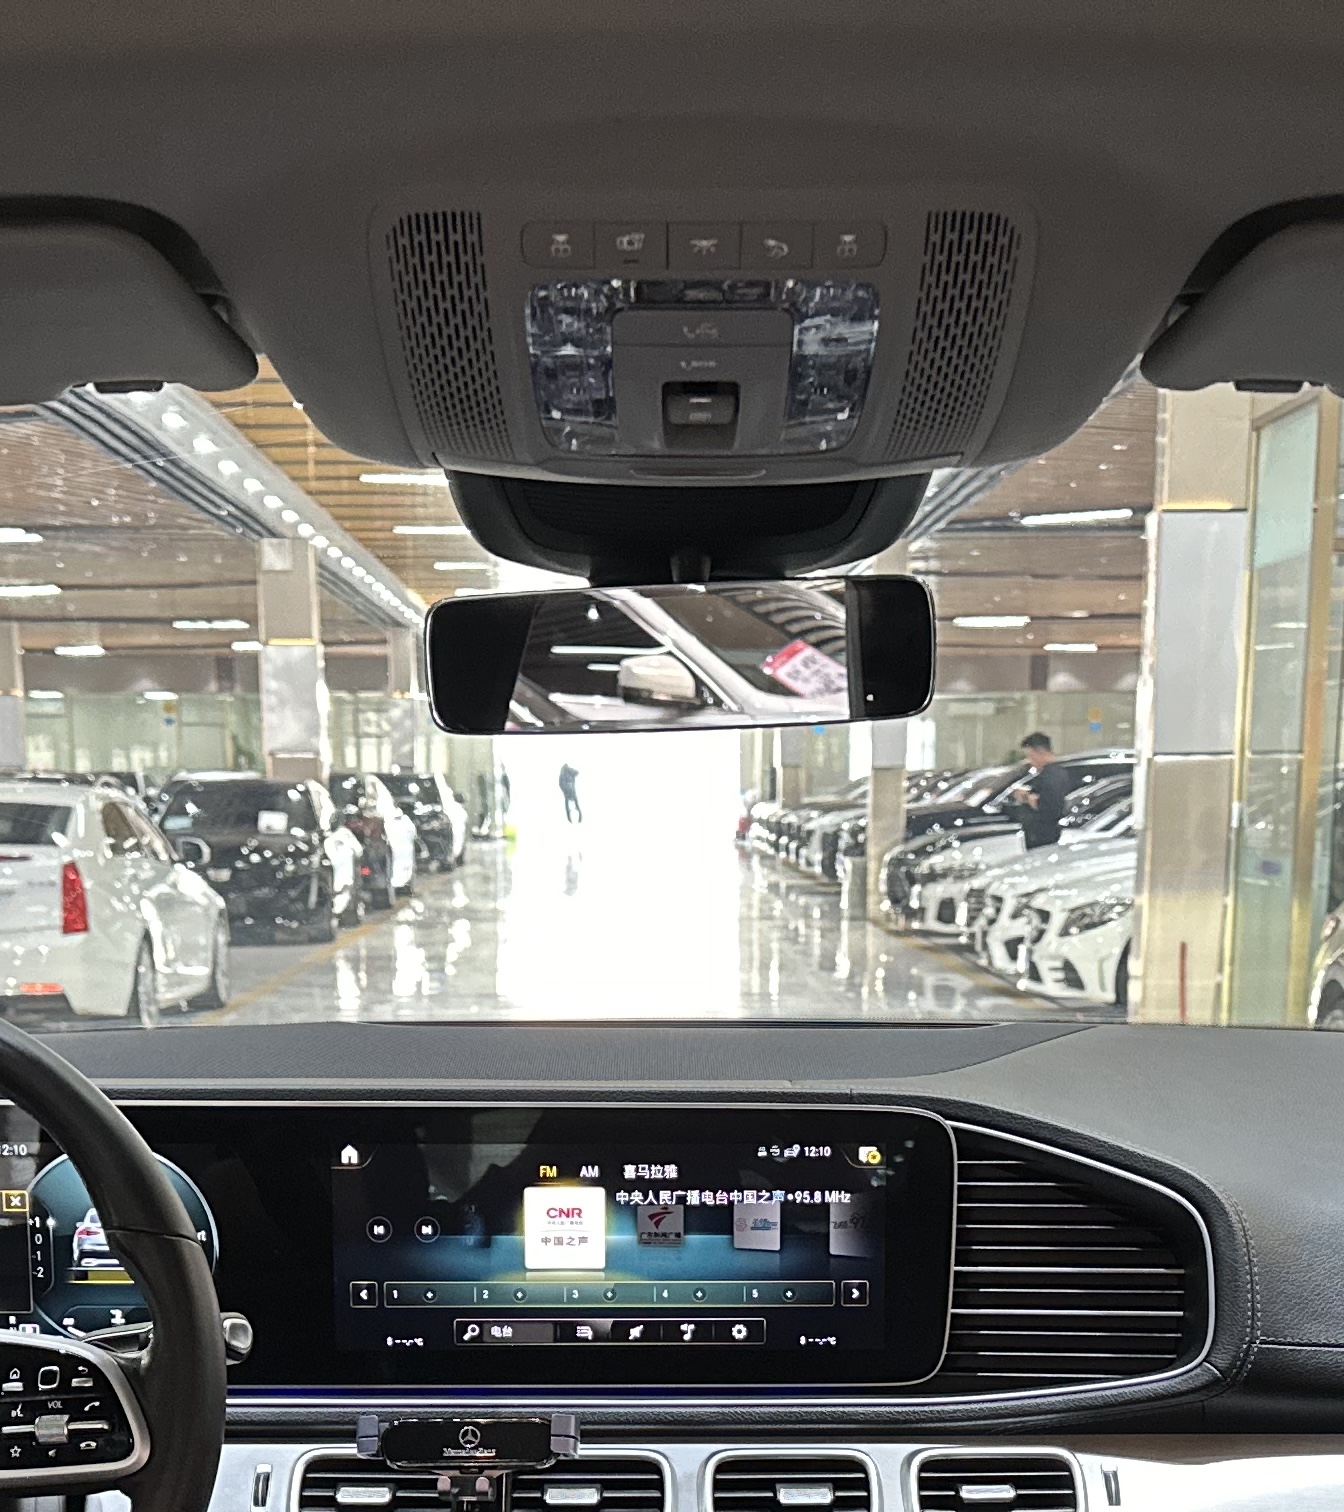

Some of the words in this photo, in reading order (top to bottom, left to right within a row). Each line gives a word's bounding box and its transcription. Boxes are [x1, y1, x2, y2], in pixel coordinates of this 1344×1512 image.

[804, 1146, 831, 1157] 12:10
[540, 1166, 557, 1178] FM
[580, 1166, 599, 1178] AM
[623, 1164, 678, 1179] 喜马拉雅
[825, 1191, 851, 1203] MHz
[546, 1207, 583, 1219] CNR
[35, 1234, 43, 1245] 0
[541, 1236, 589, 1246] 中国之声
[482, 1290, 489, 1299] 2
[572, 1290, 579, 1299] 3
[662, 1289, 669, 1298] 4
[752, 1289, 759, 1298] 5
[491, 1325, 513, 1337] 电台
[47, 1401, 63, 1409] VOL
